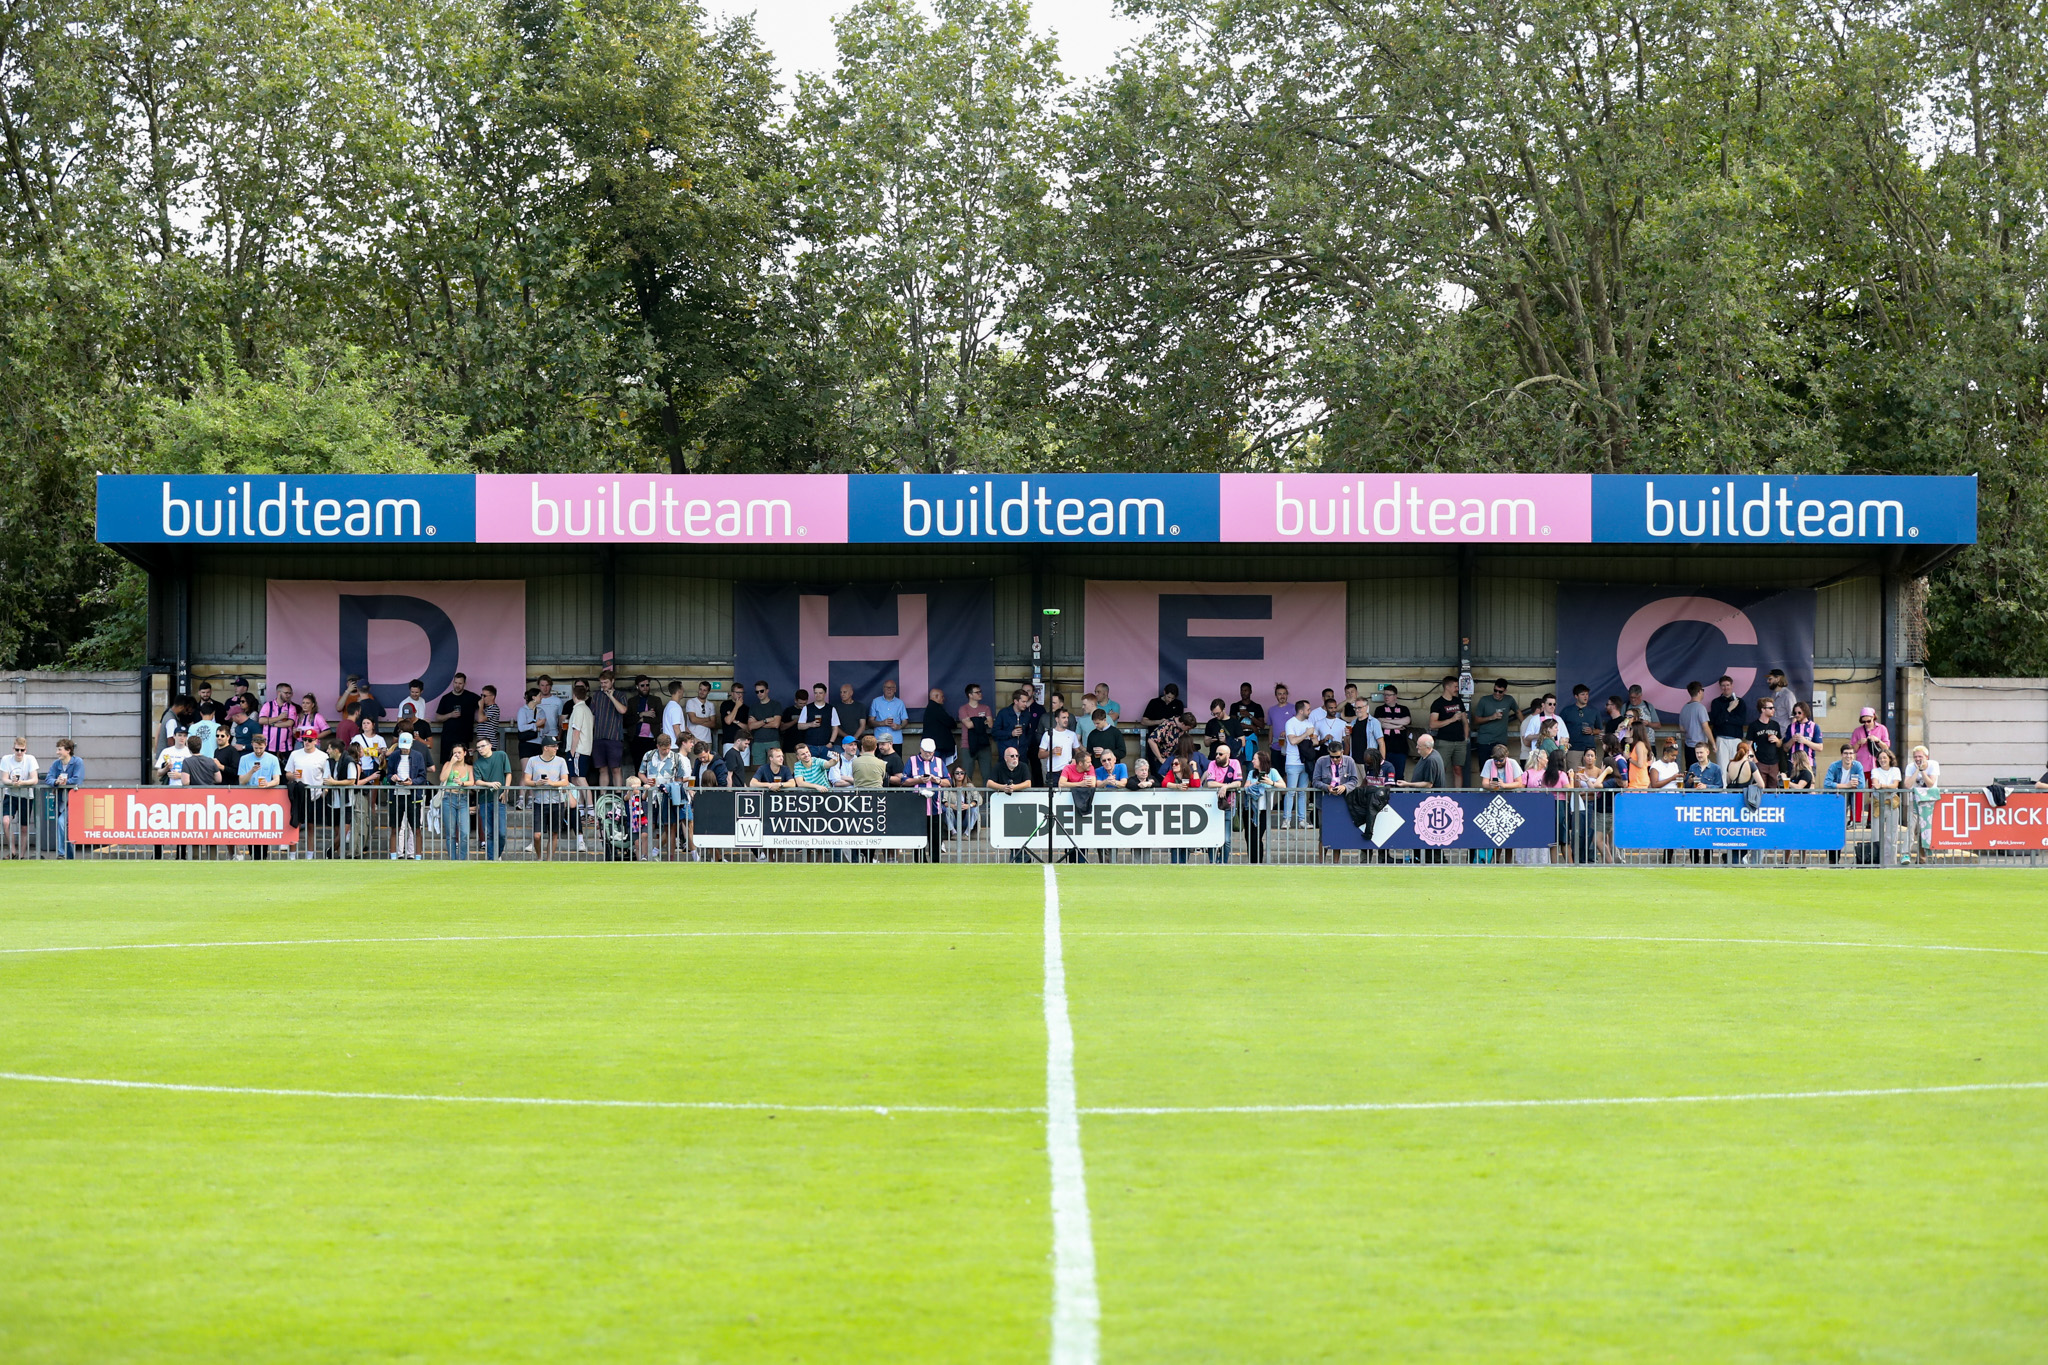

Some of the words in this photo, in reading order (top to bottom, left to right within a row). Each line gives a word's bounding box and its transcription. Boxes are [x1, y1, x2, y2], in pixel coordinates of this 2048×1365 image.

[339, 594, 459, 709] D
[799, 594, 928, 709] H
[1158, 594, 1273, 709] F
[1616, 596, 1758, 714] C
[743, 798, 755, 815] B
[769, 795, 874, 813] BESPOKE
[1436, 801, 1456, 813] HAMLET
[127, 795, 284, 831] harnham
[1674, 806, 1702, 822] THE
[1704, 806, 1739, 822] REAL
[1740, 806, 1785, 822] GREEK
[1984, 807, 2042, 825] BRICK
[741, 823, 758, 837] W
[769, 817, 875, 834] WINDOWS
[1694, 827, 1713, 836] EAT.
[1716, 827, 1767, 836] TOGETHER.
[84, 831, 101, 839] THE
[102, 831, 136, 839] GLOBAL
[137, 831, 170, 839] LEADER
[171, 831, 180, 839] IN
[181, 831, 204, 839] DATA
[212, 831, 222, 839] AI
[223, 831, 284, 839] RECRUITMENT
[773, 838, 809, 847] Reflecting
[811, 838, 843, 846] Dulwich
[844, 838, 864, 846] since
[865, 838, 882, 846] 1987
